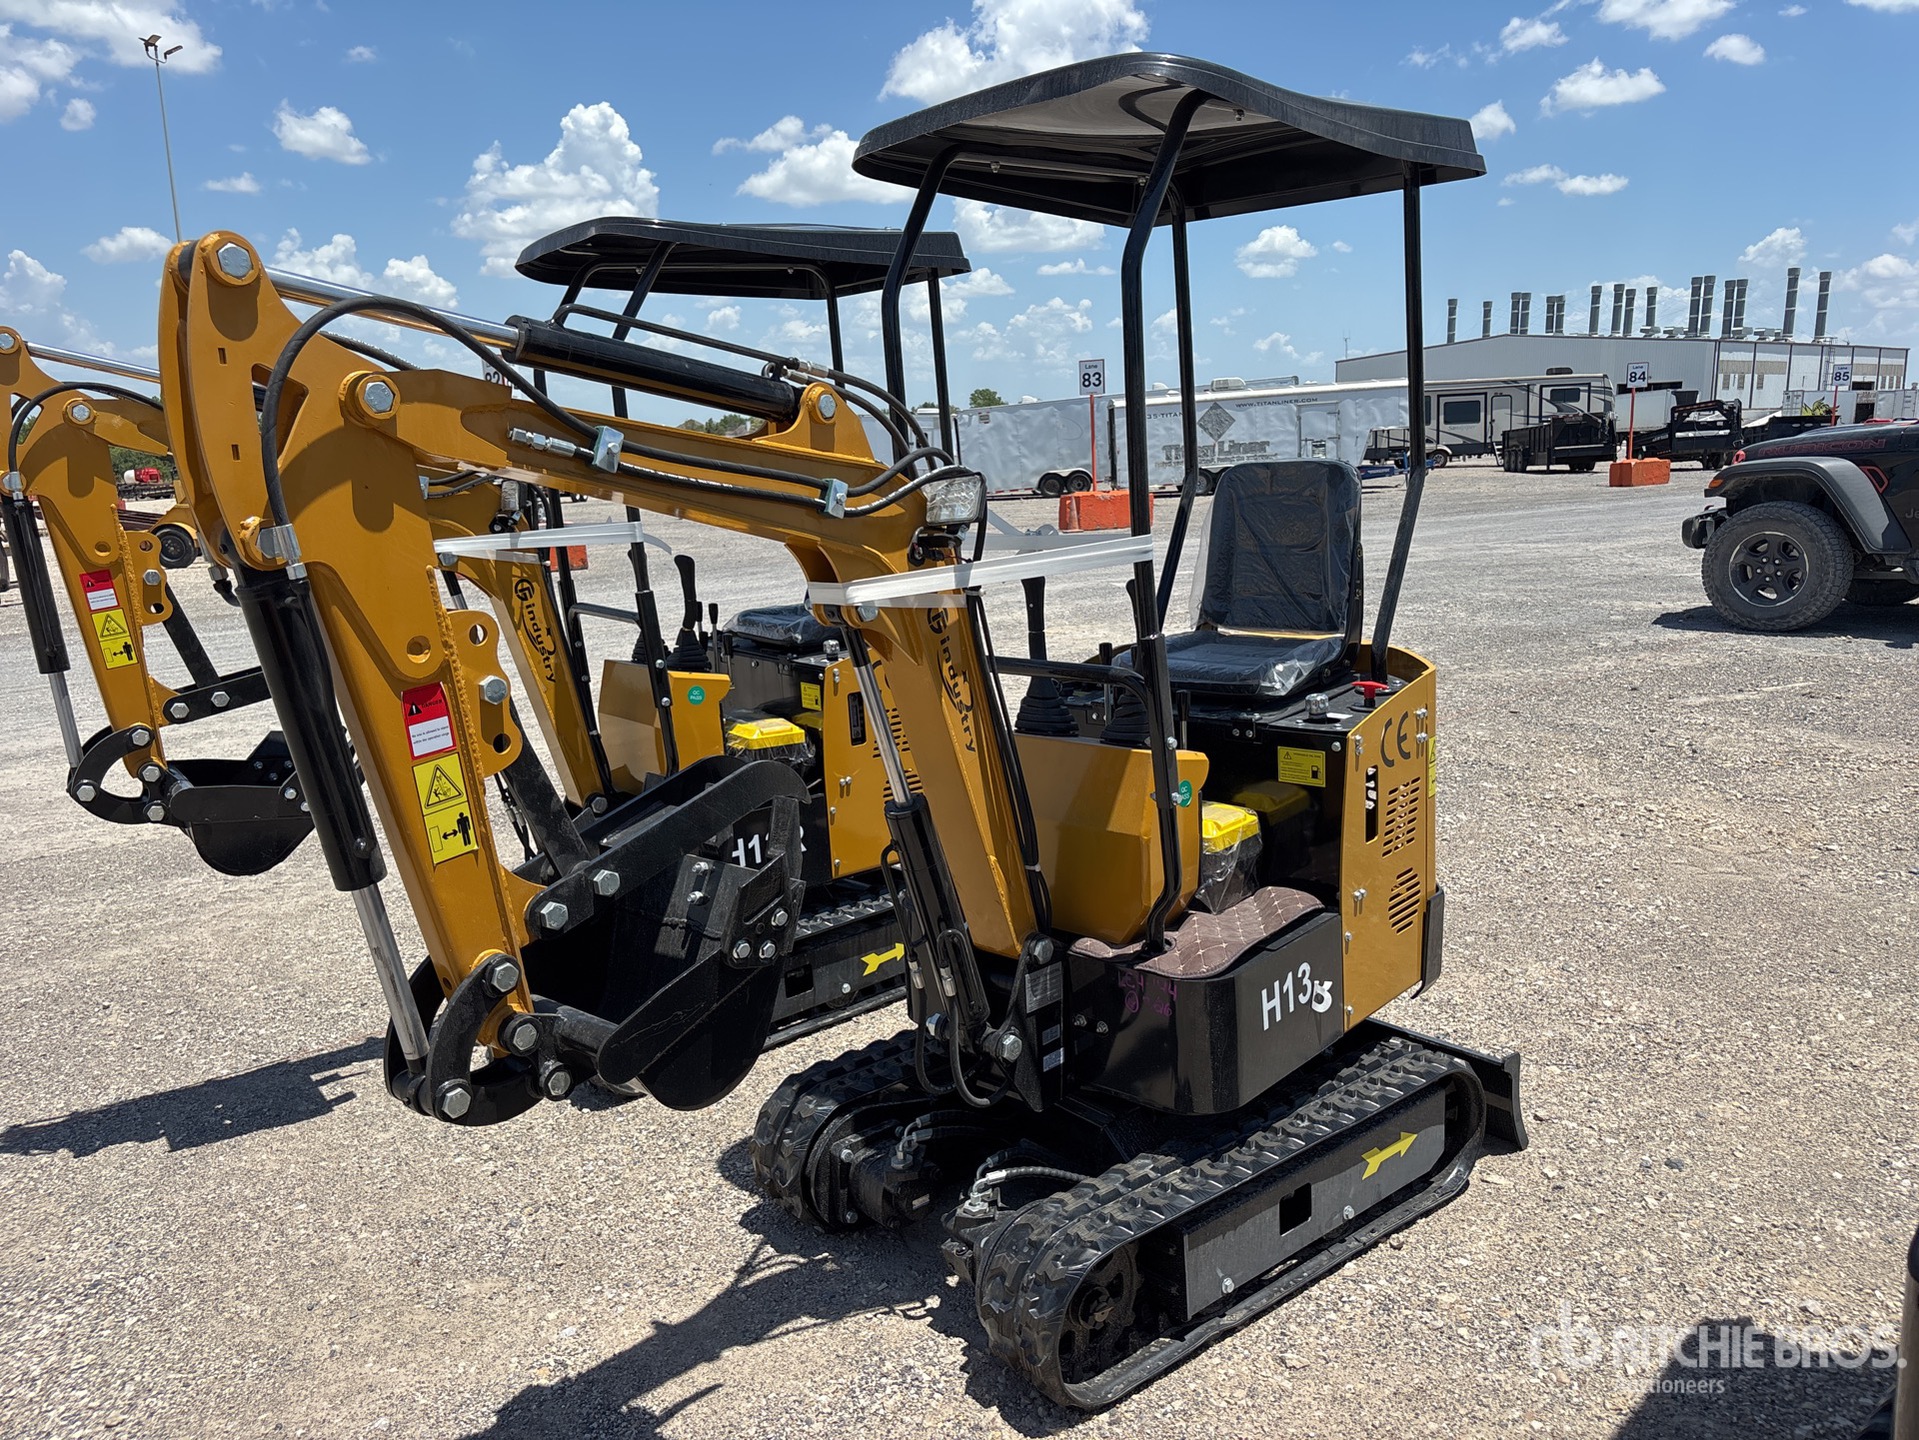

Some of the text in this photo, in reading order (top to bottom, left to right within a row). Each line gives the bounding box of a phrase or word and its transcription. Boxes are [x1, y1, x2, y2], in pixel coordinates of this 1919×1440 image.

[1082, 372, 1102, 388] 83
[1629, 371, 1646, 382] 84
[1834, 371, 1850, 381] 85
[1235, 398, 1318, 407] WWW.TITANLINER.COM
[1758, 439, 1886, 455] RUBICON
